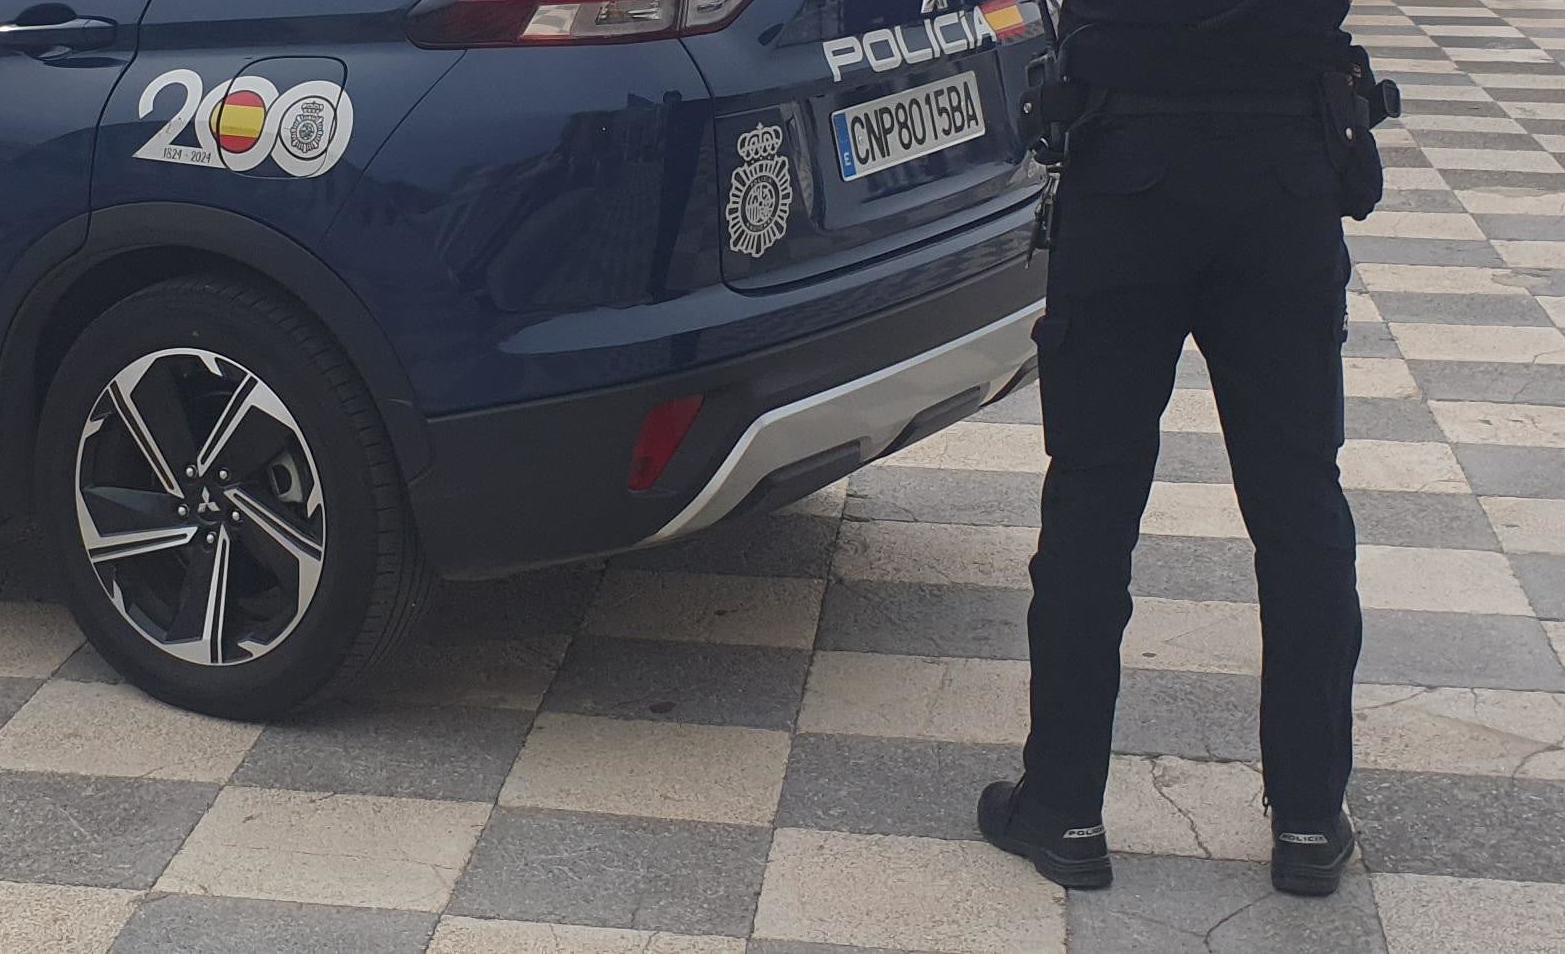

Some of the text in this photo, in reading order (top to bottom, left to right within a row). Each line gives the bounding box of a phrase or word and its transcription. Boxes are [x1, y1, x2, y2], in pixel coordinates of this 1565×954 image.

[132, 69, 354, 178] 200
[163, 147, 212, 164] 1824 2024
[851, 81, 979, 165] CNP8015BA
